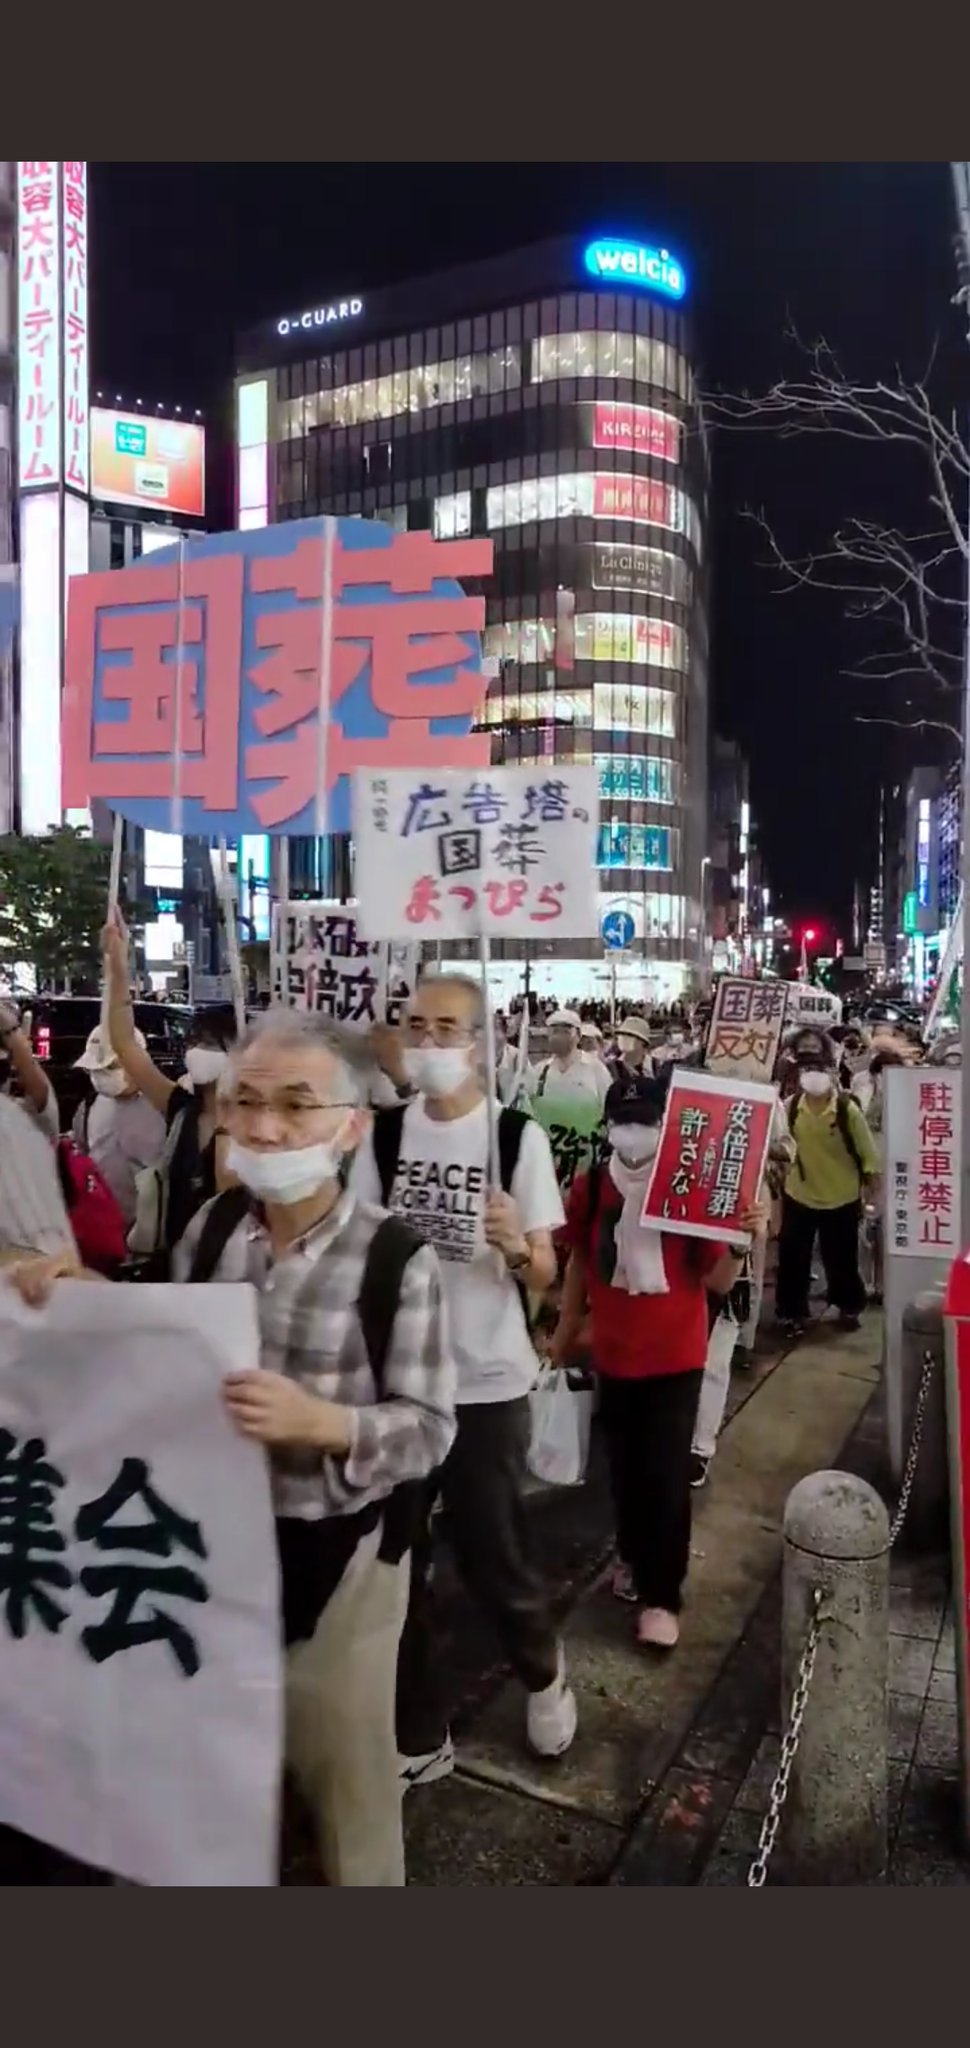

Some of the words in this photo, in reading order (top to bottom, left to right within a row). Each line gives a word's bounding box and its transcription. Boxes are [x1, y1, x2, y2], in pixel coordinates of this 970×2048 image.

[596, 248, 681, 290] welcia
[277, 298, 363, 335] Q-GUARD
[61, 530, 494, 828] 国葬
[400, 780, 590, 837] 広告塔の
[438, 823, 548, 877] 国葬
[719, 983, 784, 1024] 国葬
[711, 1026, 776, 1065] 反対
[396, 1159, 483, 1193] PEACE
[663, 1106, 709, 1218] 許さない
[709, 1101, 752, 1219] 安倍国葬
[919, 1082, 953, 1246] 駐停車禁止
[437, 1191, 478, 1216] ALL
[0, 1427, 208, 1677] 集会
